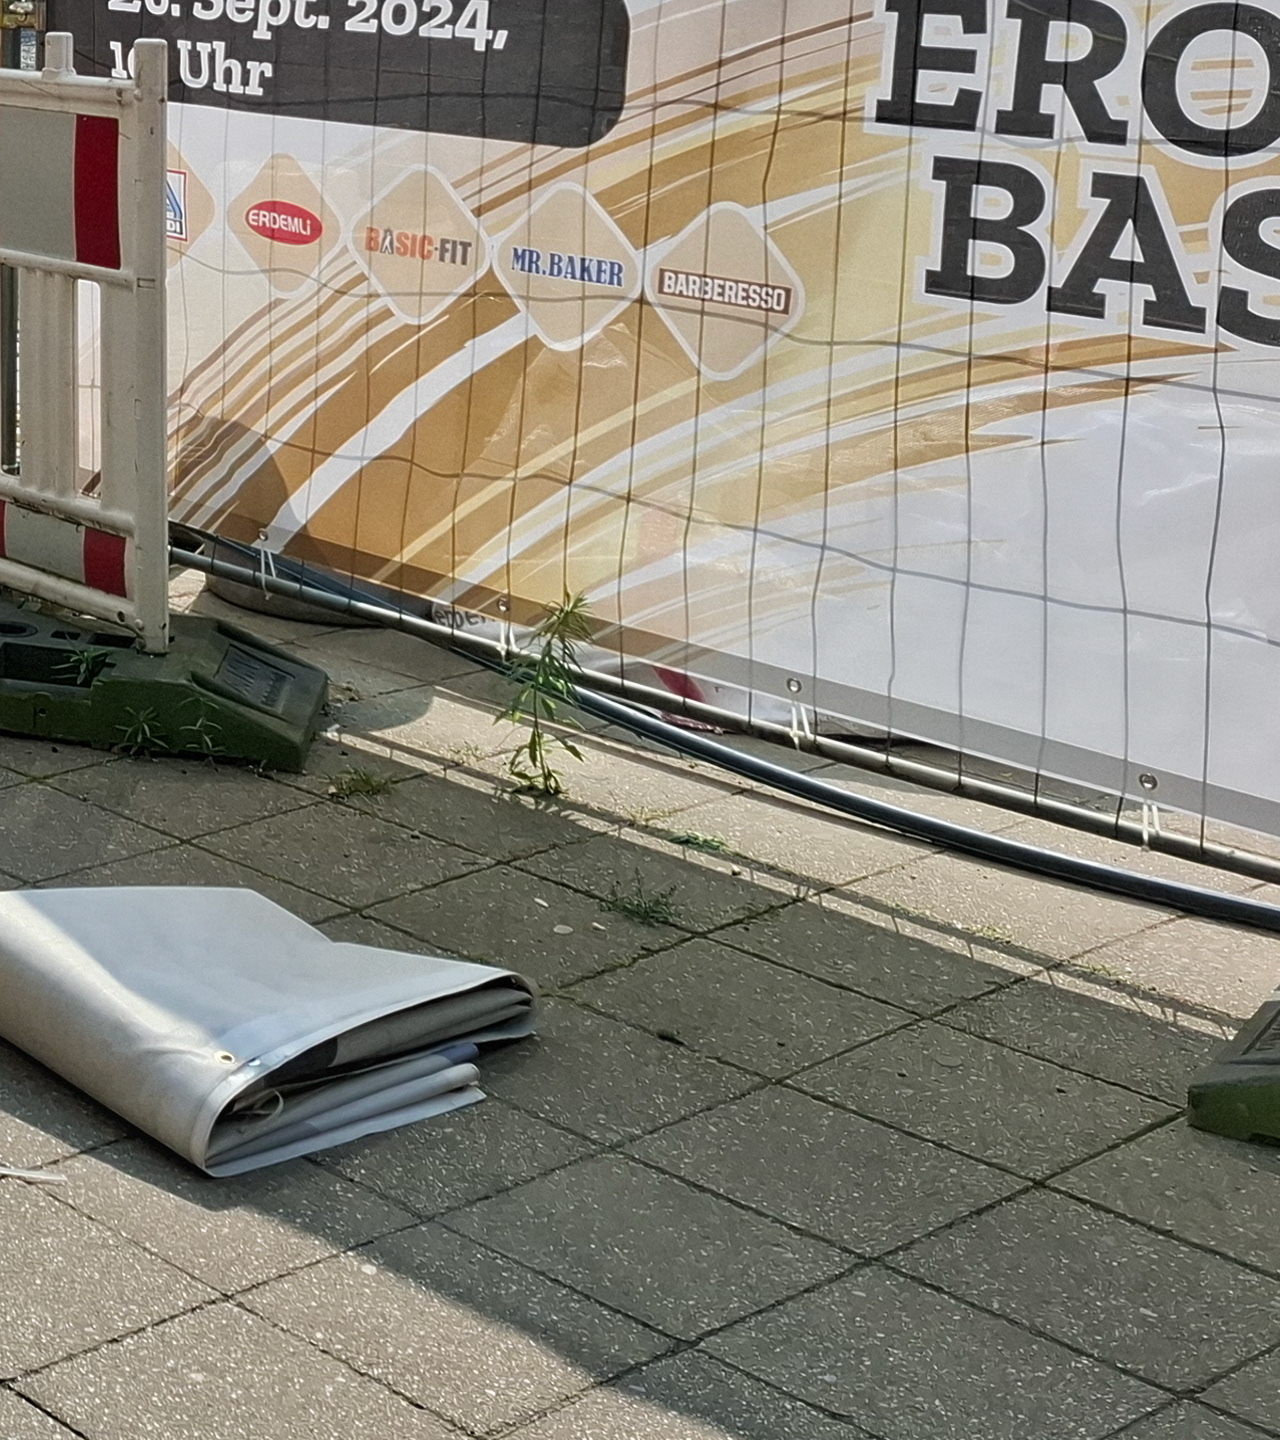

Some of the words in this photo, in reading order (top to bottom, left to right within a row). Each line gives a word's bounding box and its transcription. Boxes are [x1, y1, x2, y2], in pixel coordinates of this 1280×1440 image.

[109, 40, 135, 79] 1
[176, 39, 273, 96] Uhr
[662, 270, 786, 311] BARBERESSO
